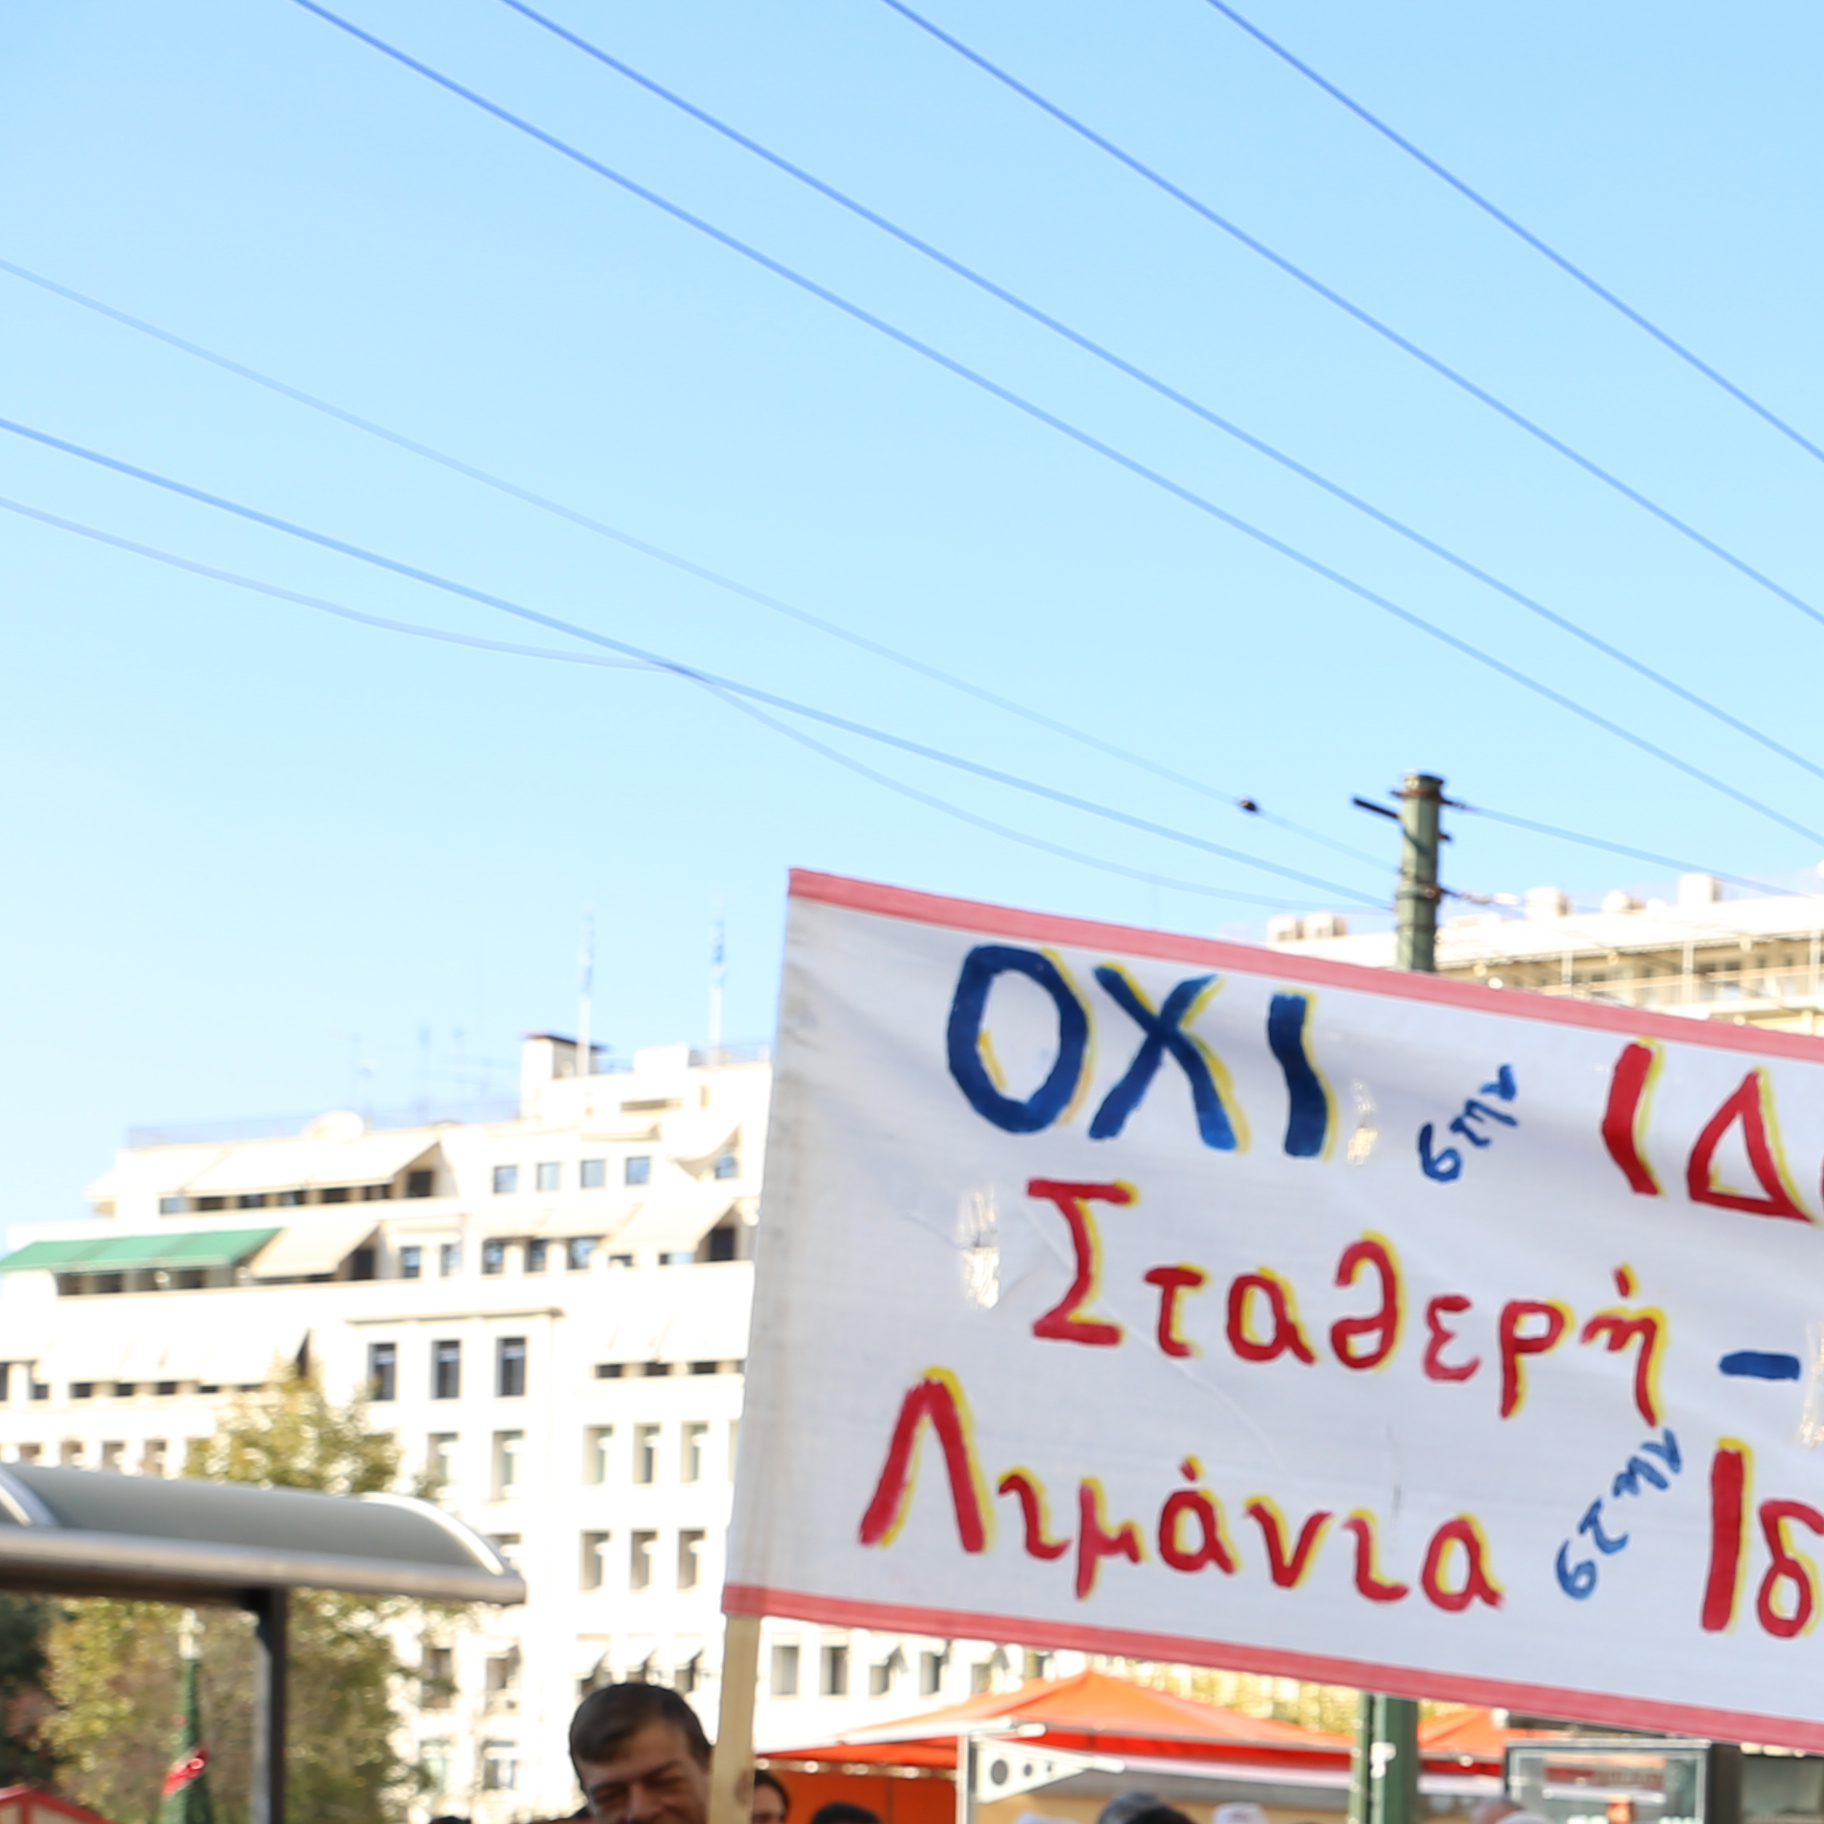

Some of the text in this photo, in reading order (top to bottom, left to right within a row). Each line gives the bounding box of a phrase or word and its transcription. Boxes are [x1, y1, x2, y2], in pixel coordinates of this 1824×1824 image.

[947, 943, 1330, 1161] ΟΧΙ
[1027, 1177, 1670, 1429] Σταθερή
[859, 1367, 1506, 1613] Λιμάνια
